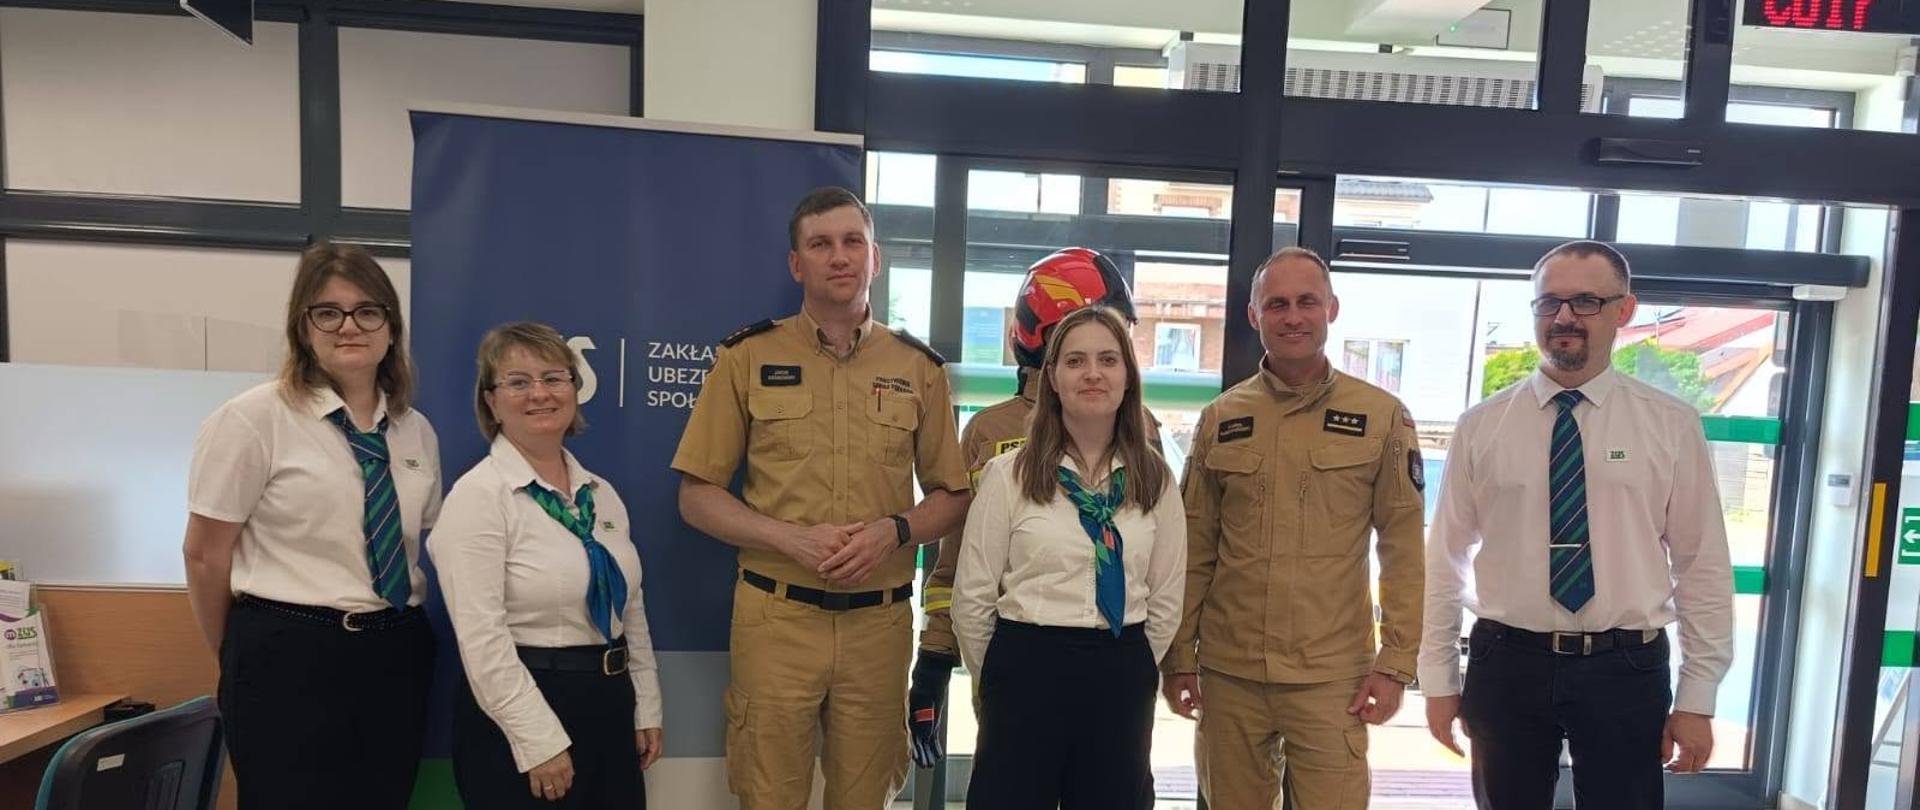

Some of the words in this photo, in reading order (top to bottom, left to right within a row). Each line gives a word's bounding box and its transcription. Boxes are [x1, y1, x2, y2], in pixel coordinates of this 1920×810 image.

[648, 342, 716, 361] ZAKŁA
[647, 390, 699, 409] SPOŁ
[1000, 440, 1026, 454] PS
